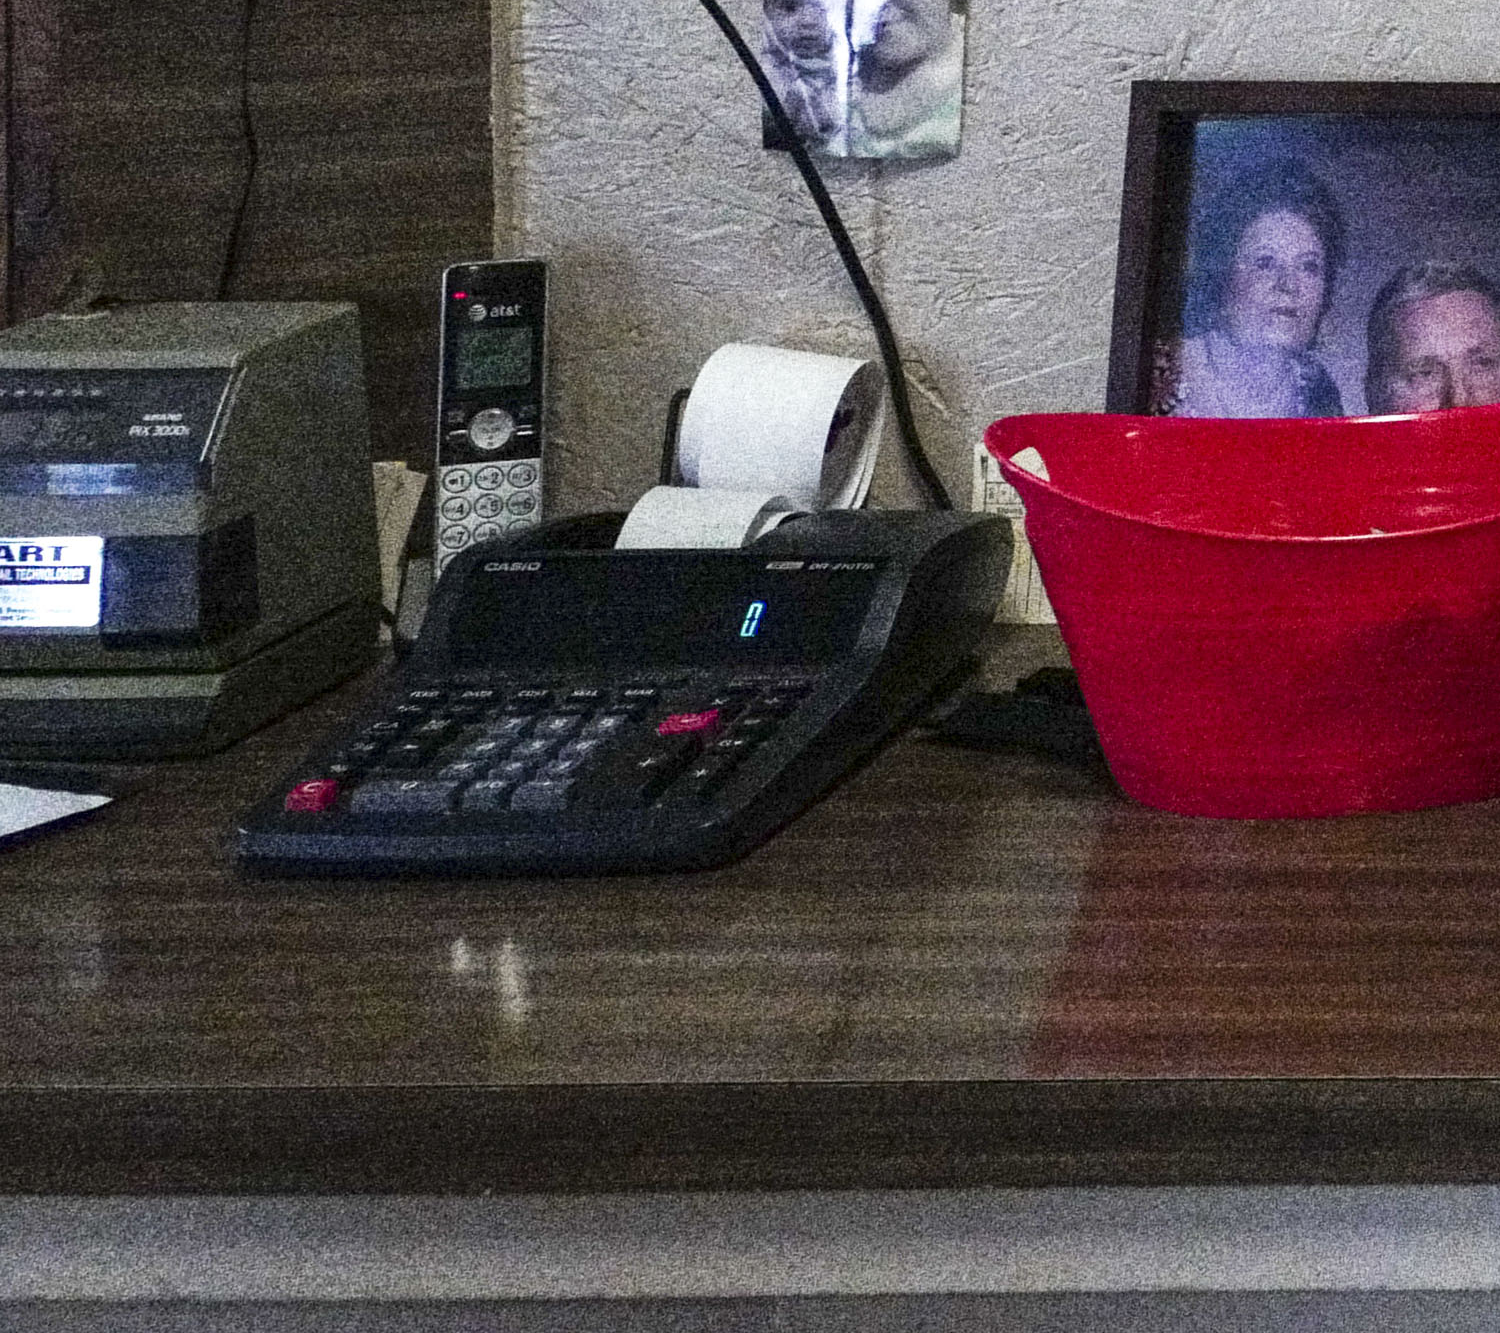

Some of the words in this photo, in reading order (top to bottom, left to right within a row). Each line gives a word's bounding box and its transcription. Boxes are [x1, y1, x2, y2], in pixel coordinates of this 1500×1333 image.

[489, 303, 522, 319] at&t
[483, 561, 542, 572] CASIO
[16, 567, 86, 583] TECHNOLOGIES
[740, 600, 767, 638] 0
